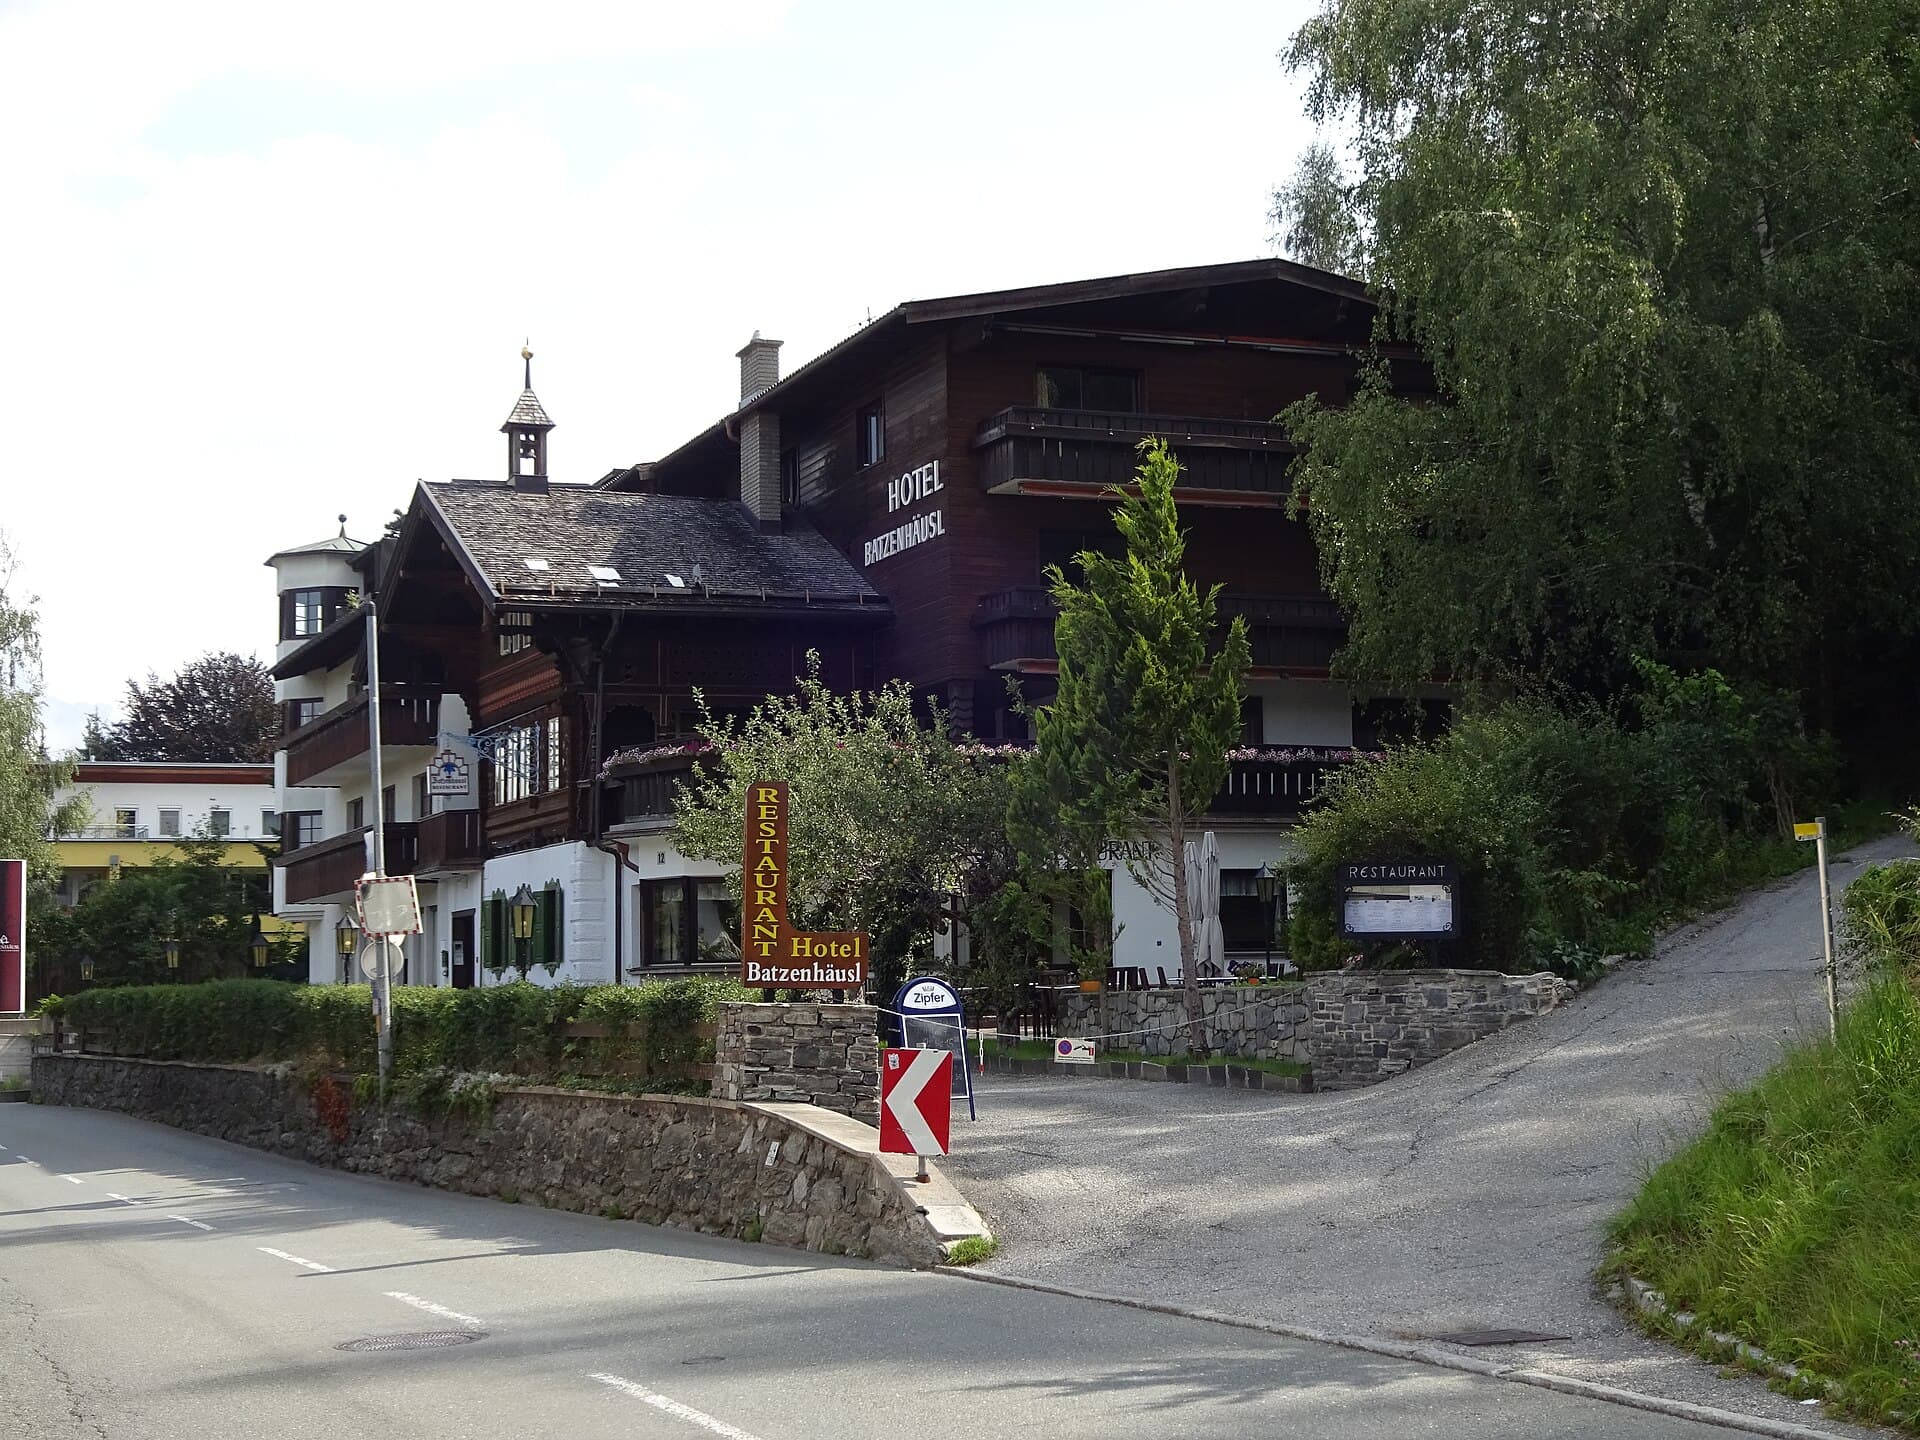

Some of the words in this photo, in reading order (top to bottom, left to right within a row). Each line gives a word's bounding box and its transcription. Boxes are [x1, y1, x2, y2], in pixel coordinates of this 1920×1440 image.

[888, 460, 944, 513] HOTEL
[864, 510, 945, 567] BATZENHÄUSL
[754, 788, 780, 957] RESTAURANT
[1349, 865, 1446, 878] RESTAURANT
[790, 937, 861, 958] Hotel
[747, 961, 861, 982] Batzenhäusl
[914, 992, 946, 1006] Zipfer
